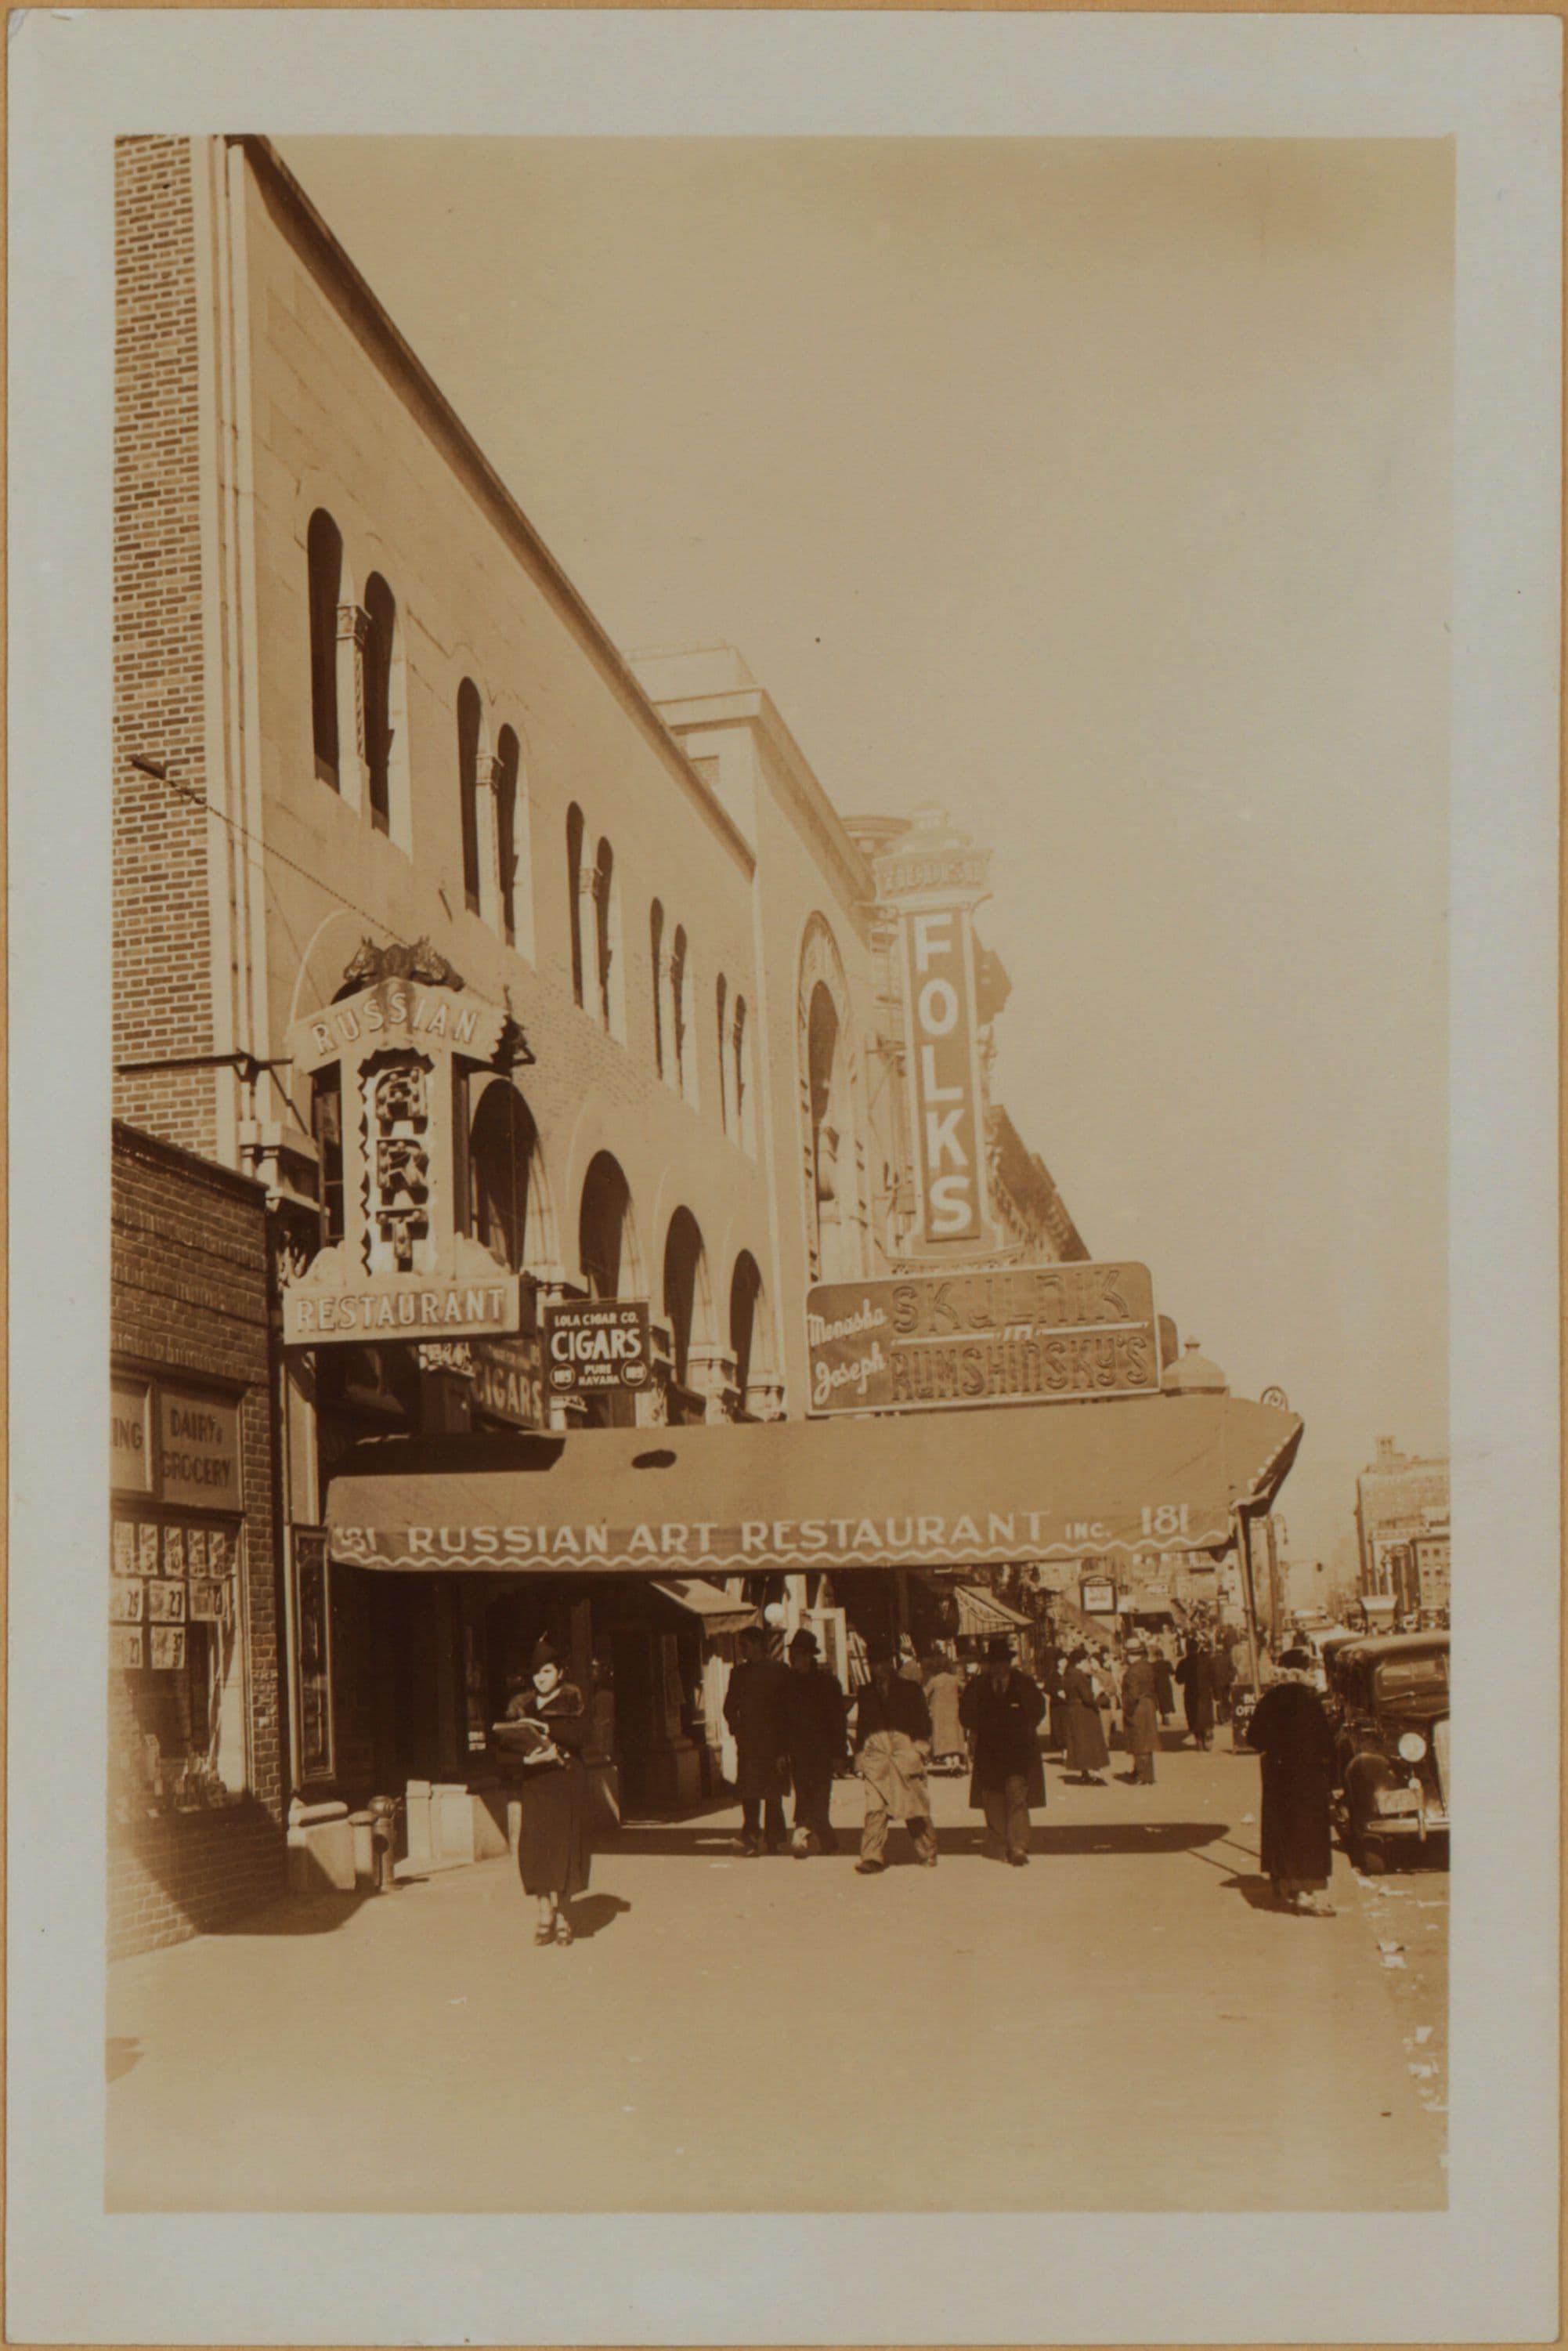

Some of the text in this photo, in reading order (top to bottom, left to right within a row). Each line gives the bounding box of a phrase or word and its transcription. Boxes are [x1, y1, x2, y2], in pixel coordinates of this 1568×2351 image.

[313, 992, 479, 1055] RUSSIAN
[913, 913, 973, 1234] FOLKS
[375, 1067, 430, 1273] ART
[296, 1289, 506, 1332] RESTAURANT
[582, 1312, 617, 1326] CIGAR
[807, 1298, 887, 1347] Menasha
[551, 1328, 642, 1362] CIGARS
[471, 1361, 543, 1419] CIGARS
[813, 1341, 887, 1404] Joseph
[159, 1450, 231, 1487] GROCERY
[406, 1525, 609, 1554] RUSSIAN
[628, 1522, 719, 1553] ART
[743, 1510, 1051, 1553] RESTAURANT
[1064, 1522, 1112, 1539] INC.
[1140, 1503, 1189, 1535] 181
